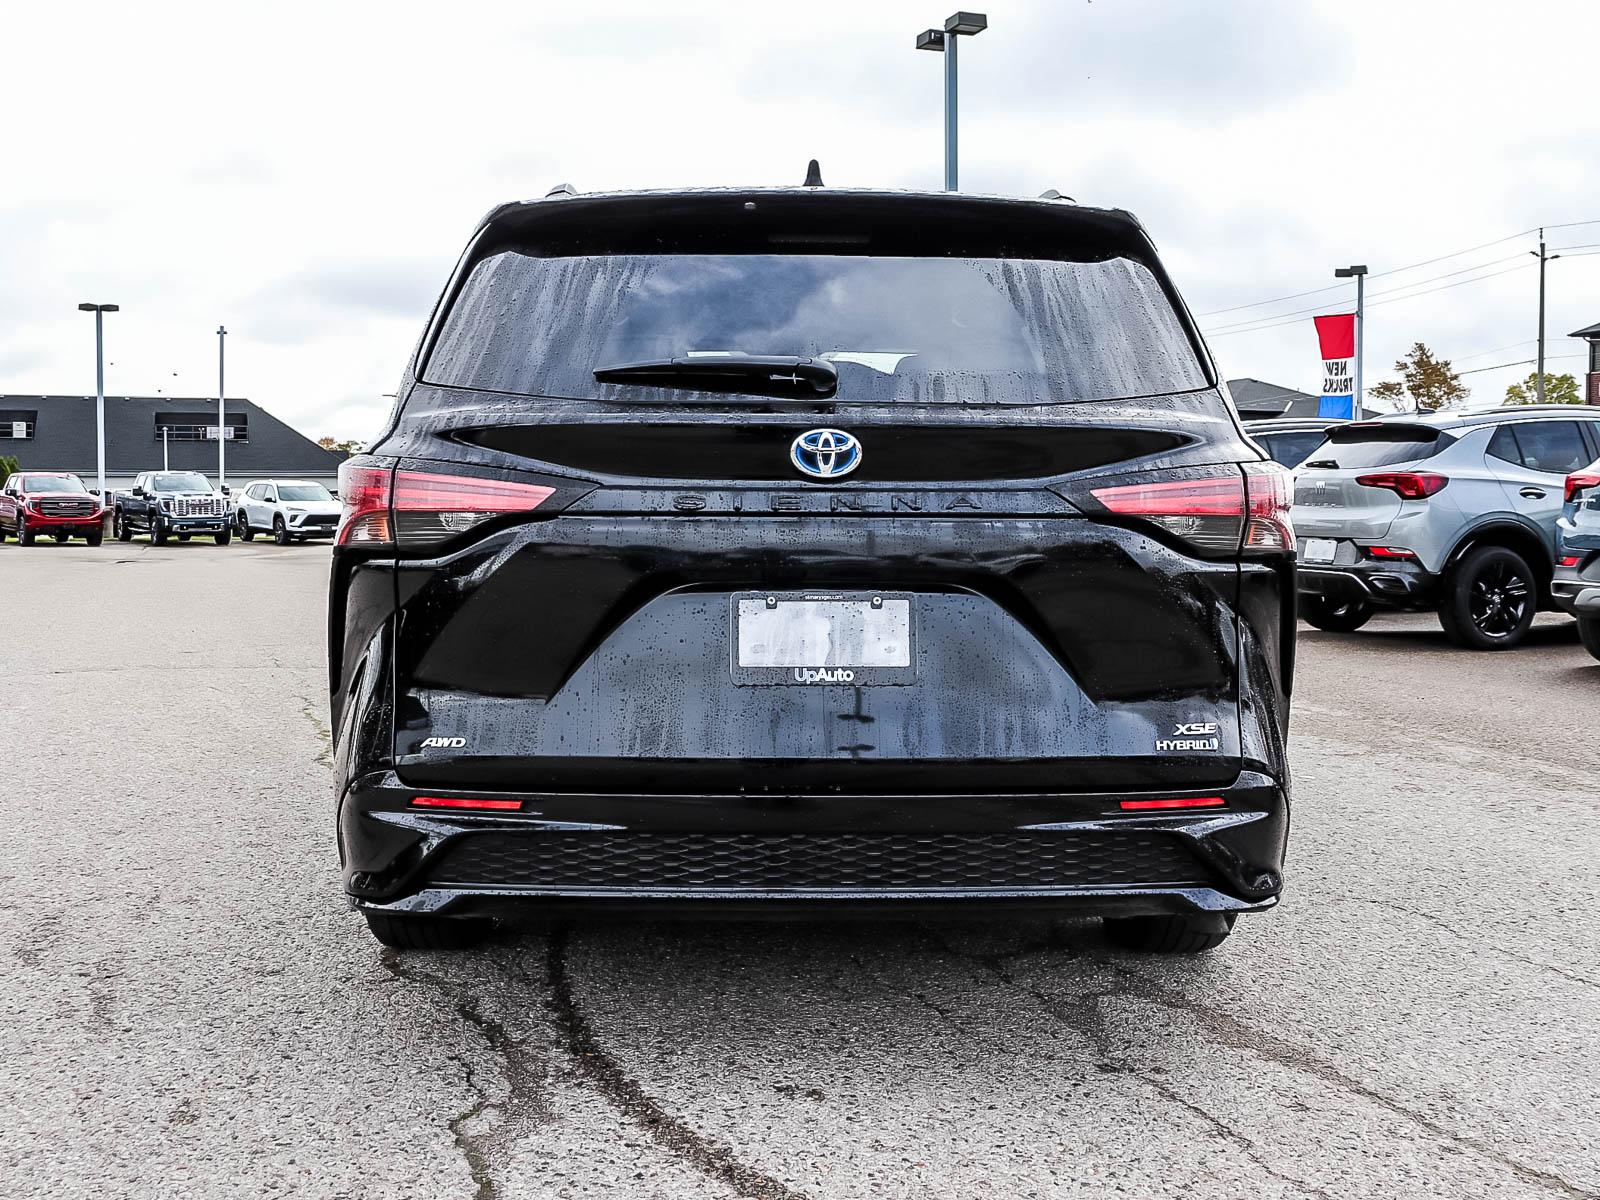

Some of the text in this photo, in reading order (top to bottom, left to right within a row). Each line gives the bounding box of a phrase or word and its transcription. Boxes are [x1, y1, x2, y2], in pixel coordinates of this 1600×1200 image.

[672, 494, 983, 511] SIENNA
[794, 667, 855, 684] UpAuto
[1172, 722, 1217, 736] XSE
[420, 737, 467, 748] AWD
[1156, 740, 1211, 751] HYBRID
